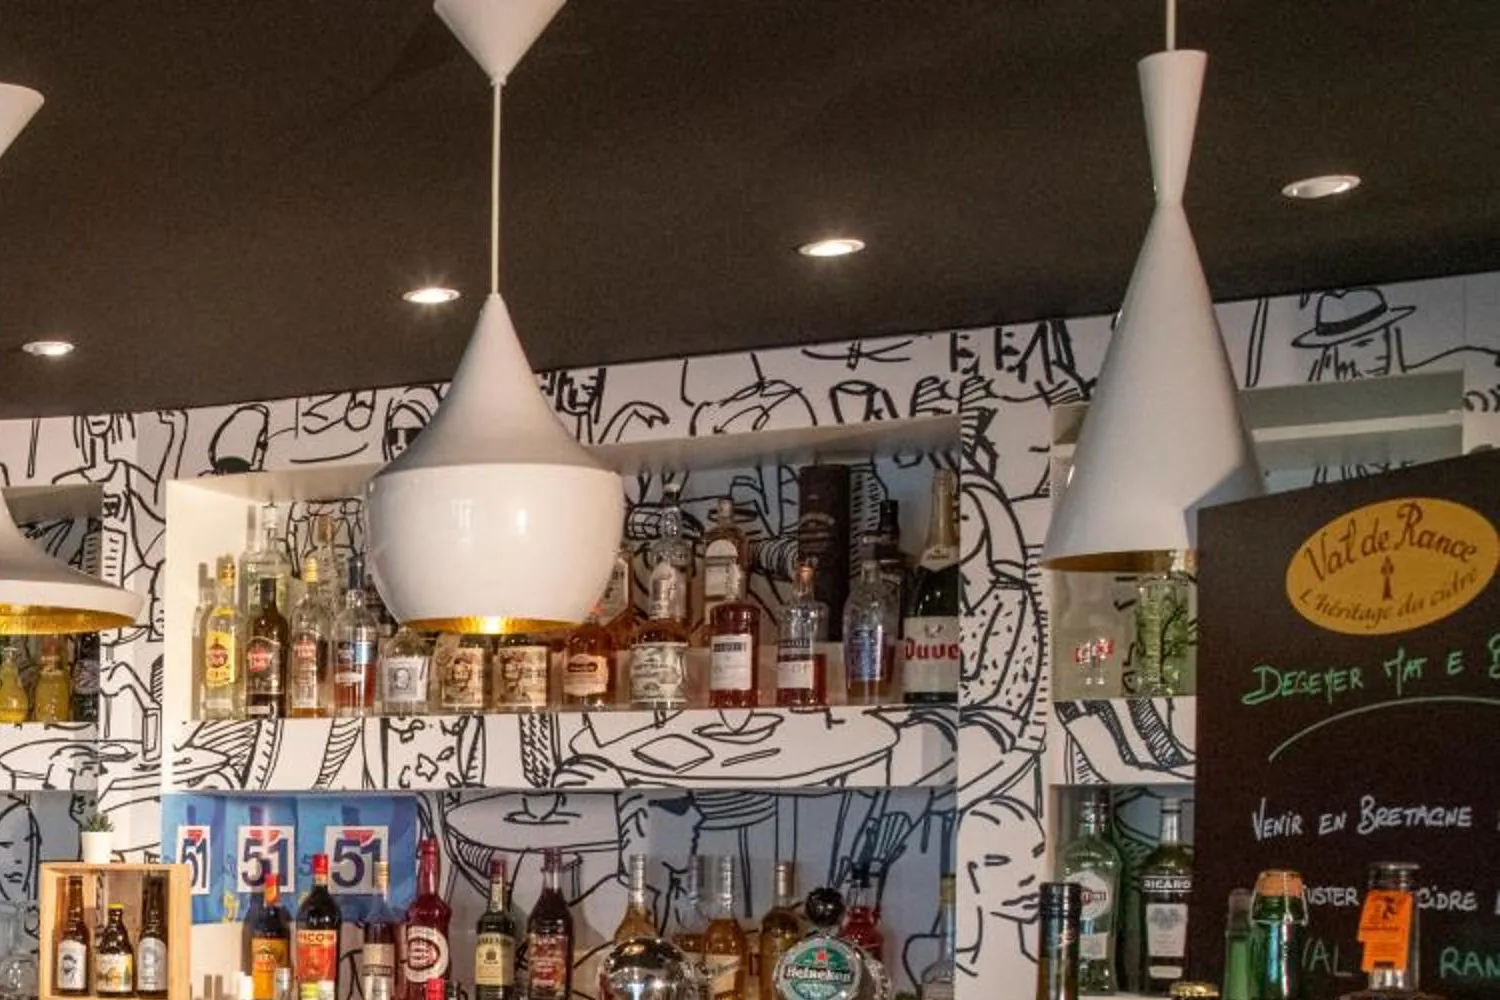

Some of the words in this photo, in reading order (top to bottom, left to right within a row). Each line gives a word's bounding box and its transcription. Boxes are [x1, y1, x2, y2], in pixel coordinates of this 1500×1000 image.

[1303, 516, 1357, 582] Val
[1361, 516, 1390, 556] de
[1393, 500, 1478, 563] Rance
[1396, 592, 1425, 617] du
[904, 637, 960, 661] Duve
[1318, 810, 1348, 836] EN
[1356, 794, 1473, 836] BRETAGNE
[181, 837, 207, 889] 51
[241, 837, 288, 887] 51
[331, 838, 382, 888] 51
[1142, 879, 1192, 890] RICARD
[1306, 886, 1360, 907] USTER
[786, 965, 852, 984] Heineken
